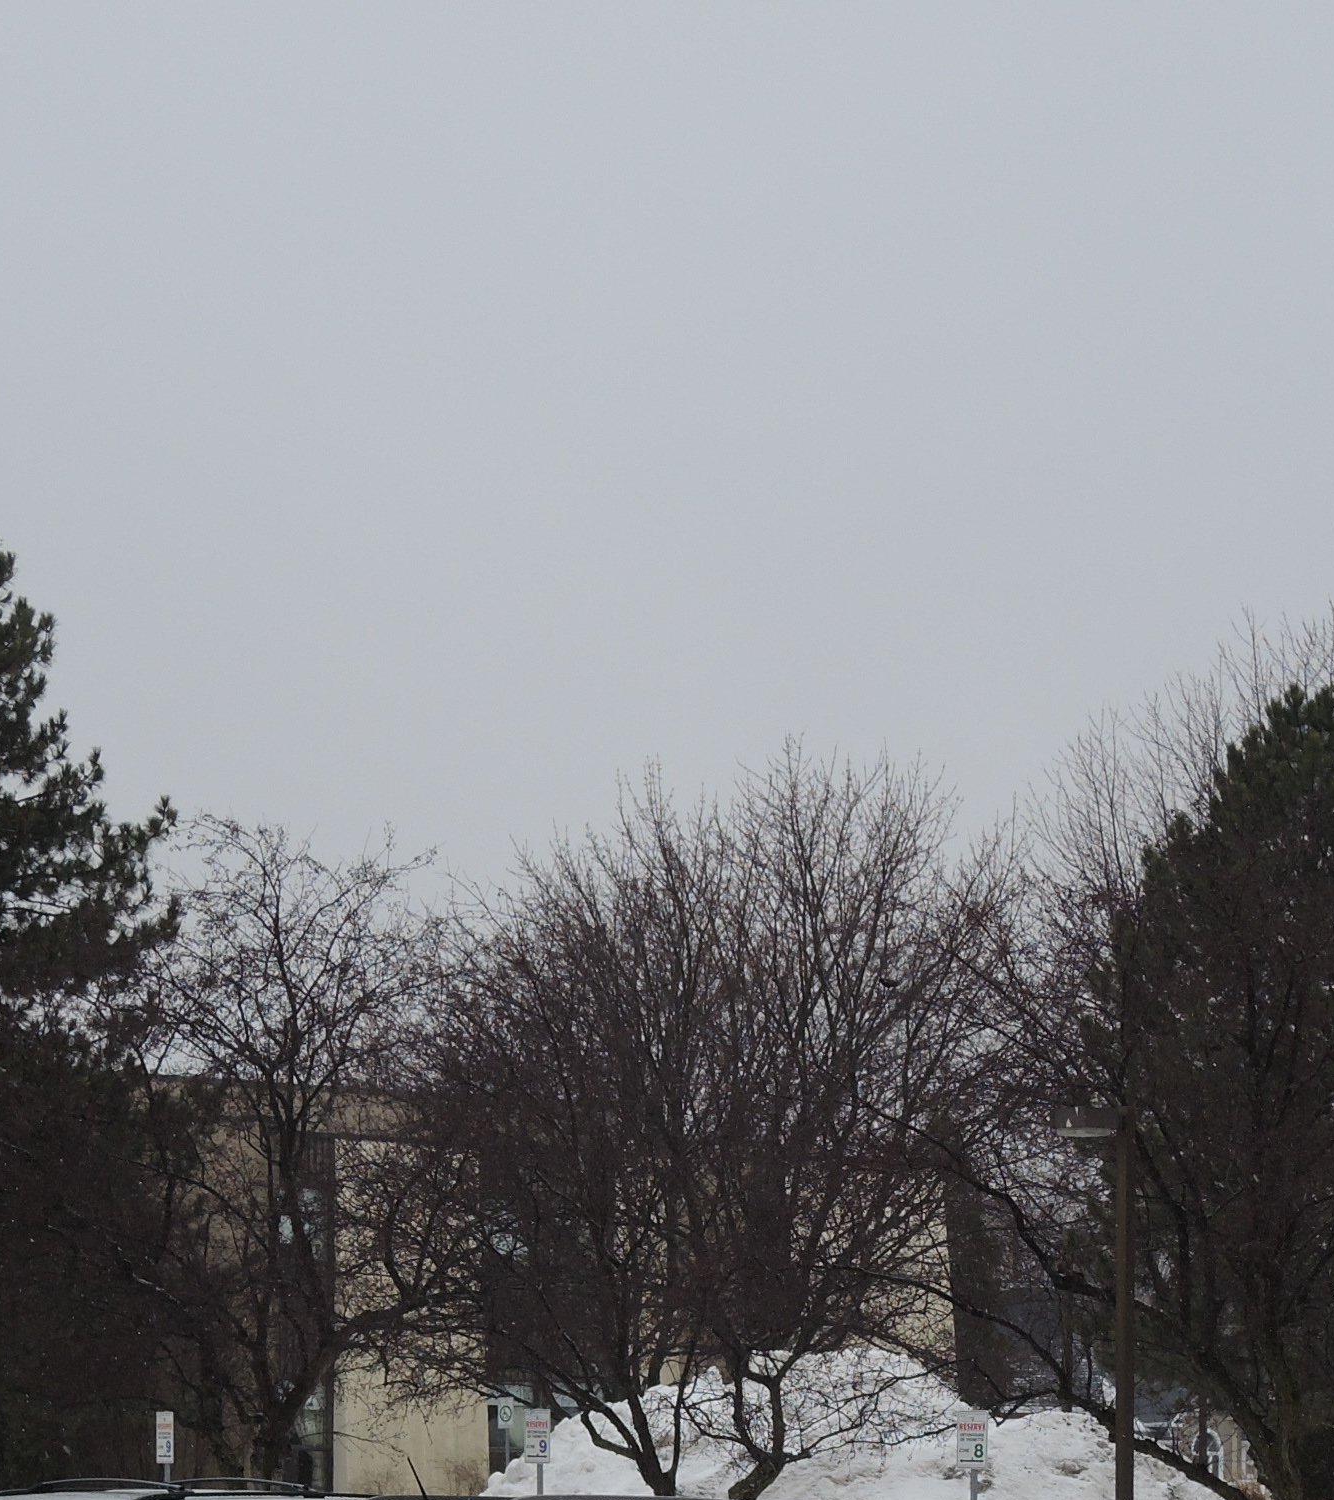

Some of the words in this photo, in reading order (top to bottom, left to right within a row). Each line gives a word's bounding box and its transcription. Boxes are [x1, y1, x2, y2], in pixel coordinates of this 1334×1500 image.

[165, 1440, 172, 1453] 9
[539, 1440, 547, 1453] 9
[974, 1444, 984, 1458] 8
